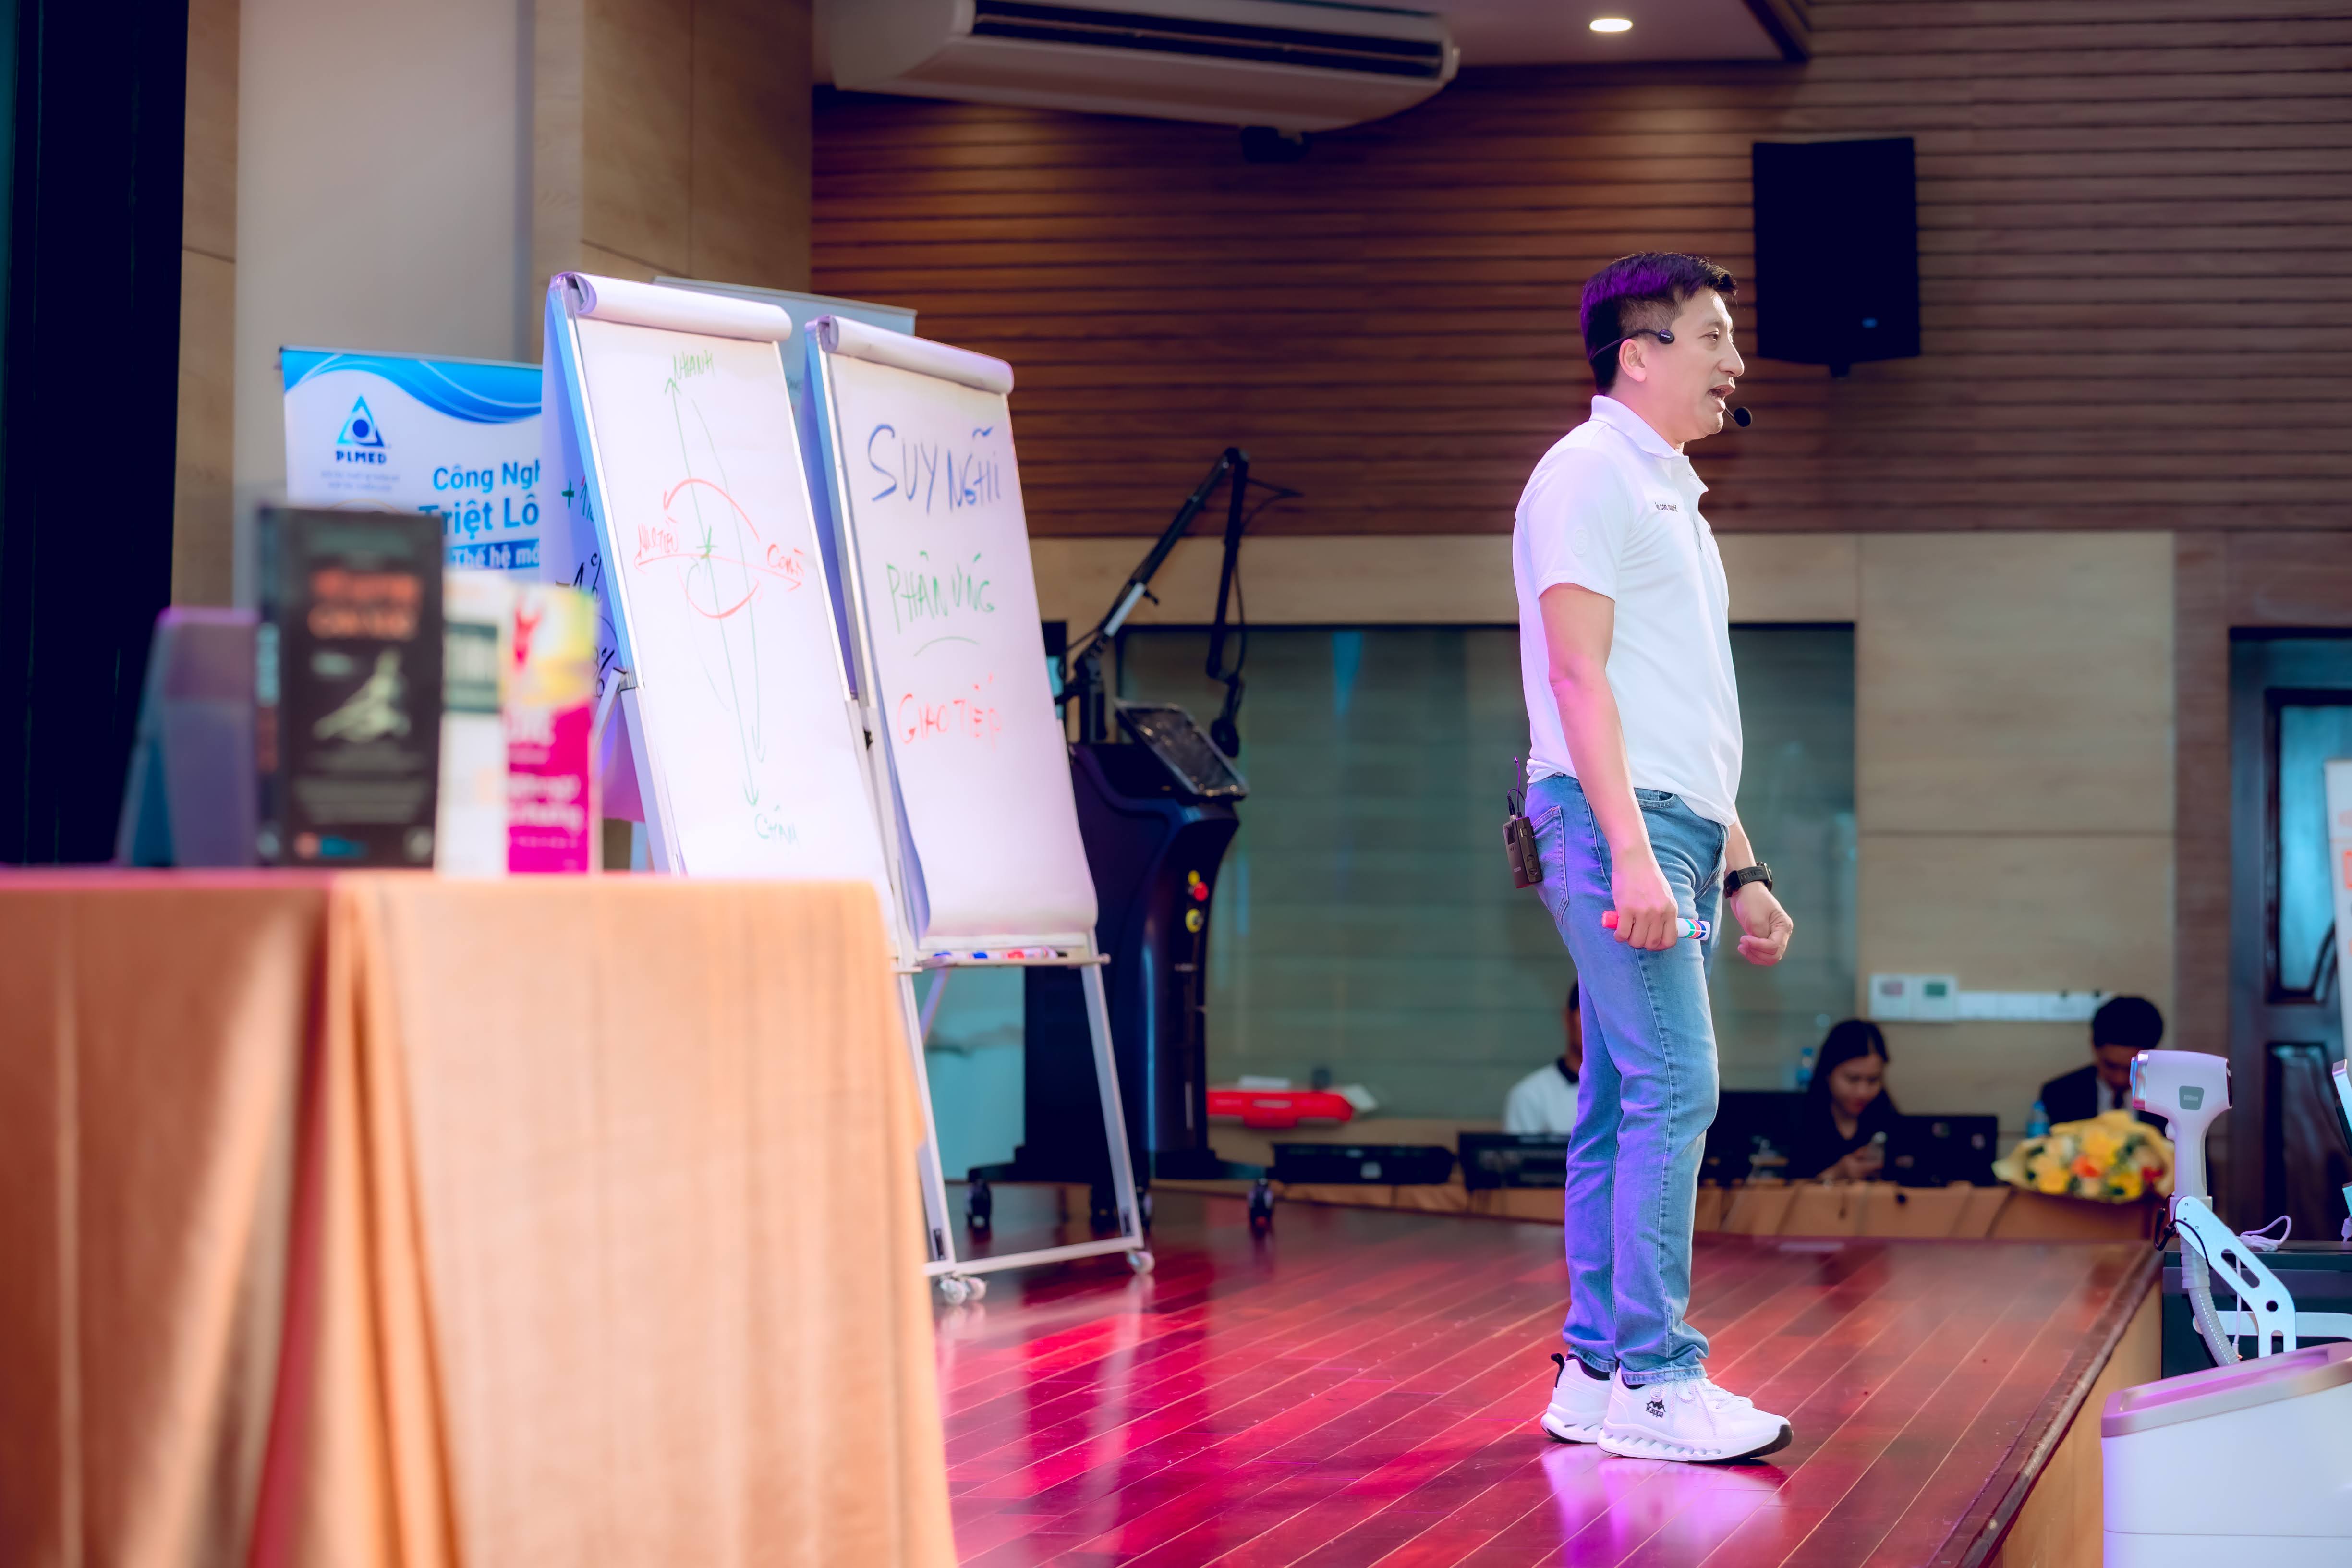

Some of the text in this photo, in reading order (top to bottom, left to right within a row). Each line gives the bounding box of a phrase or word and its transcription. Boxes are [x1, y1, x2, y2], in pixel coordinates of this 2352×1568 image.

[433, 464, 493, 493] Công
[868, 424, 1000, 515] SUY NGHĨ
[1646, 1404, 1663, 1418] Kappa
